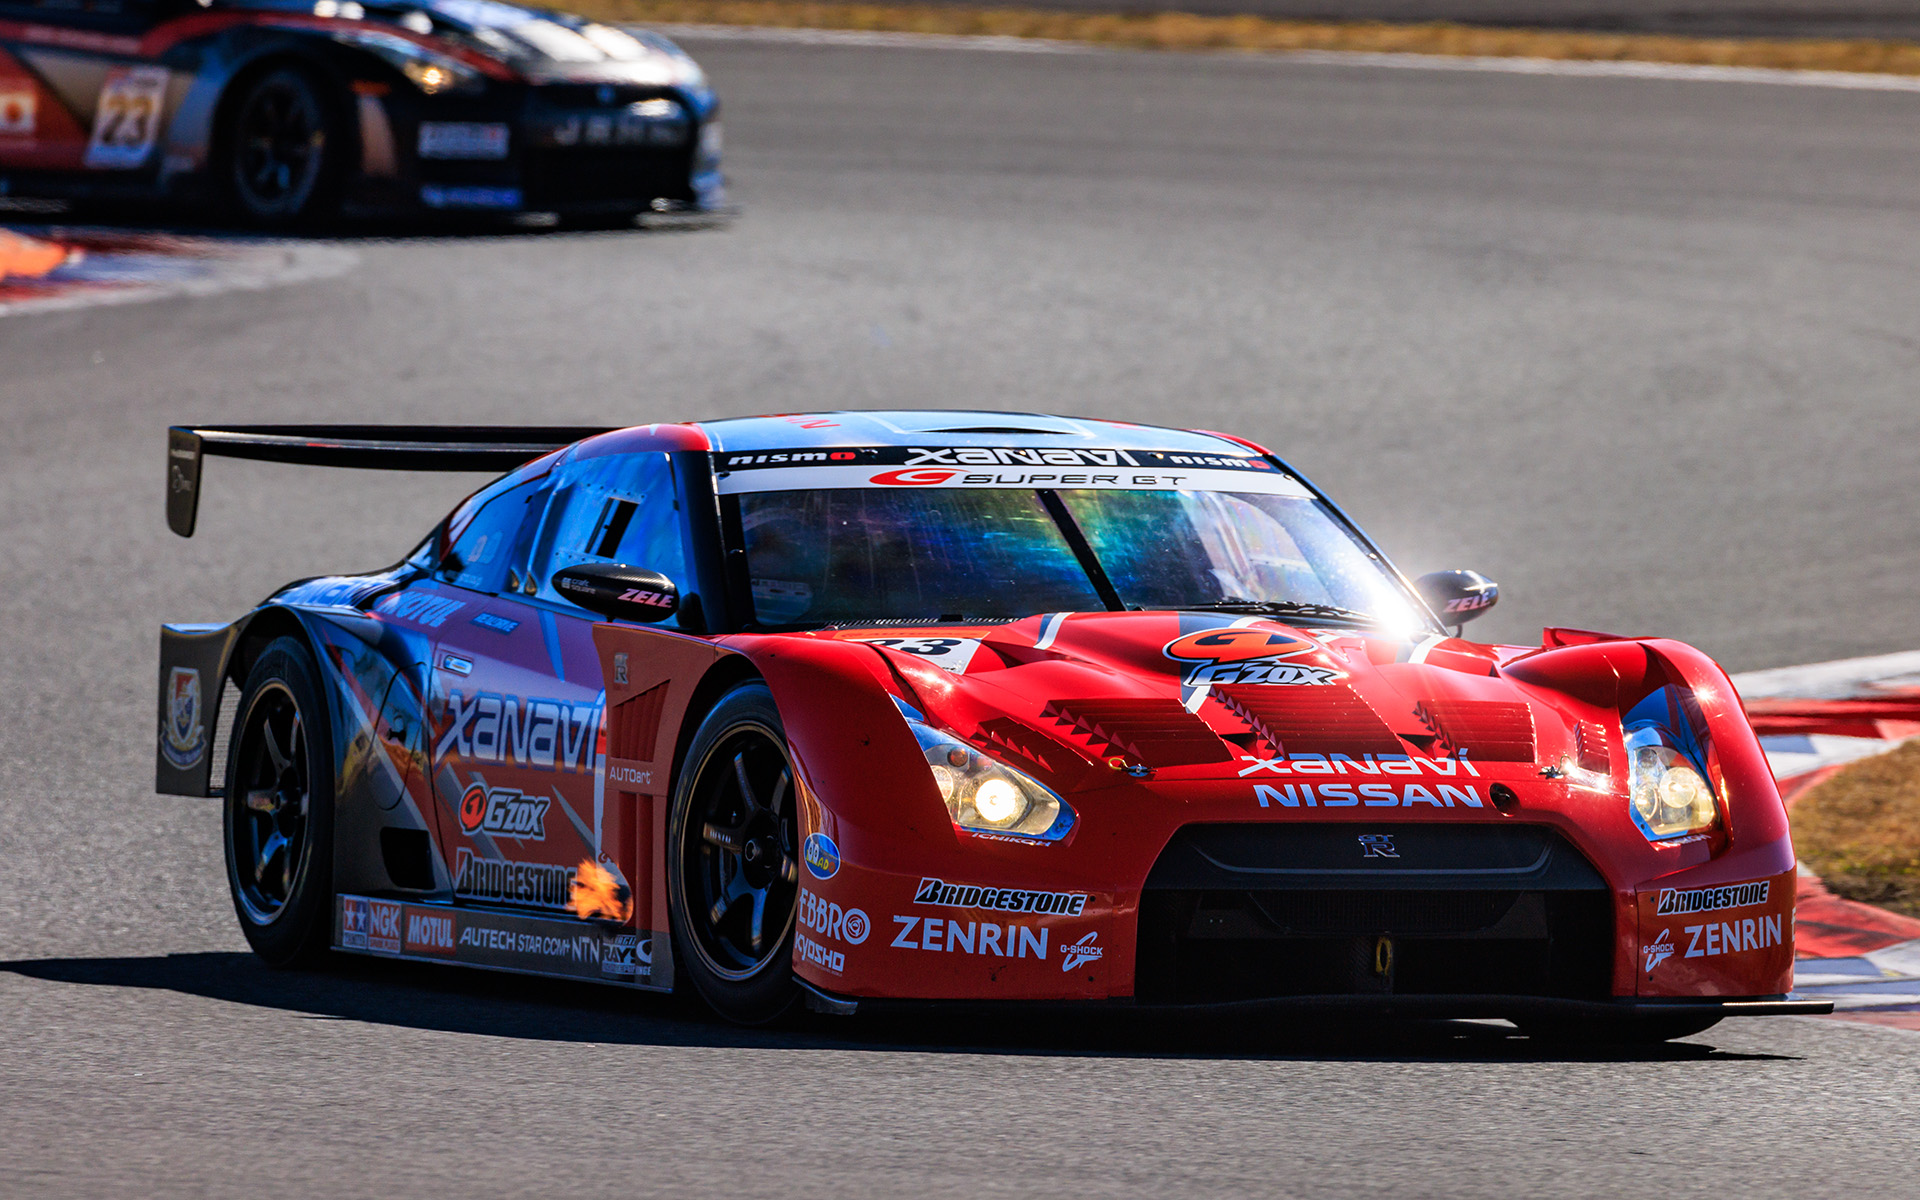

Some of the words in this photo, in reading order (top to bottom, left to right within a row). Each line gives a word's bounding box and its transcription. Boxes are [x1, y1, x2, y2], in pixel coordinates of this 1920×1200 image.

[102, 94, 153, 147] 23
[963, 474, 1119, 486] SUPER
[1132, 475, 1188, 487] GT
[375, 590, 467, 628] MOTUL
[617, 587, 675, 609] ZELE
[1442, 591, 1491, 613] ZELE
[609, 765, 652, 785] AUTOart
[1253, 783, 1484, 808] NISSAN
[971, 832, 1052, 847] ICHIKOH
[913, 877, 1087, 917] BRIDGESTONE
[1657, 880, 1770, 916] BRIDGESTONE
[369, 904, 400, 939] NGK
[407, 914, 453, 948] MOTUL
[798, 887, 871, 945] EBBRO
[459, 926, 516, 951] AUTECH
[517, 933, 542, 953] STAR
[572, 935, 600, 964] NTN
[795, 931, 845, 972] KYOSHO
[890, 914, 1049, 960] ZENRIN
[1060, 944, 1104, 956] G-SHOCK
[1643, 942, 1675, 954] G-SHOCK
[1684, 913, 1782, 959] ZENRIN
